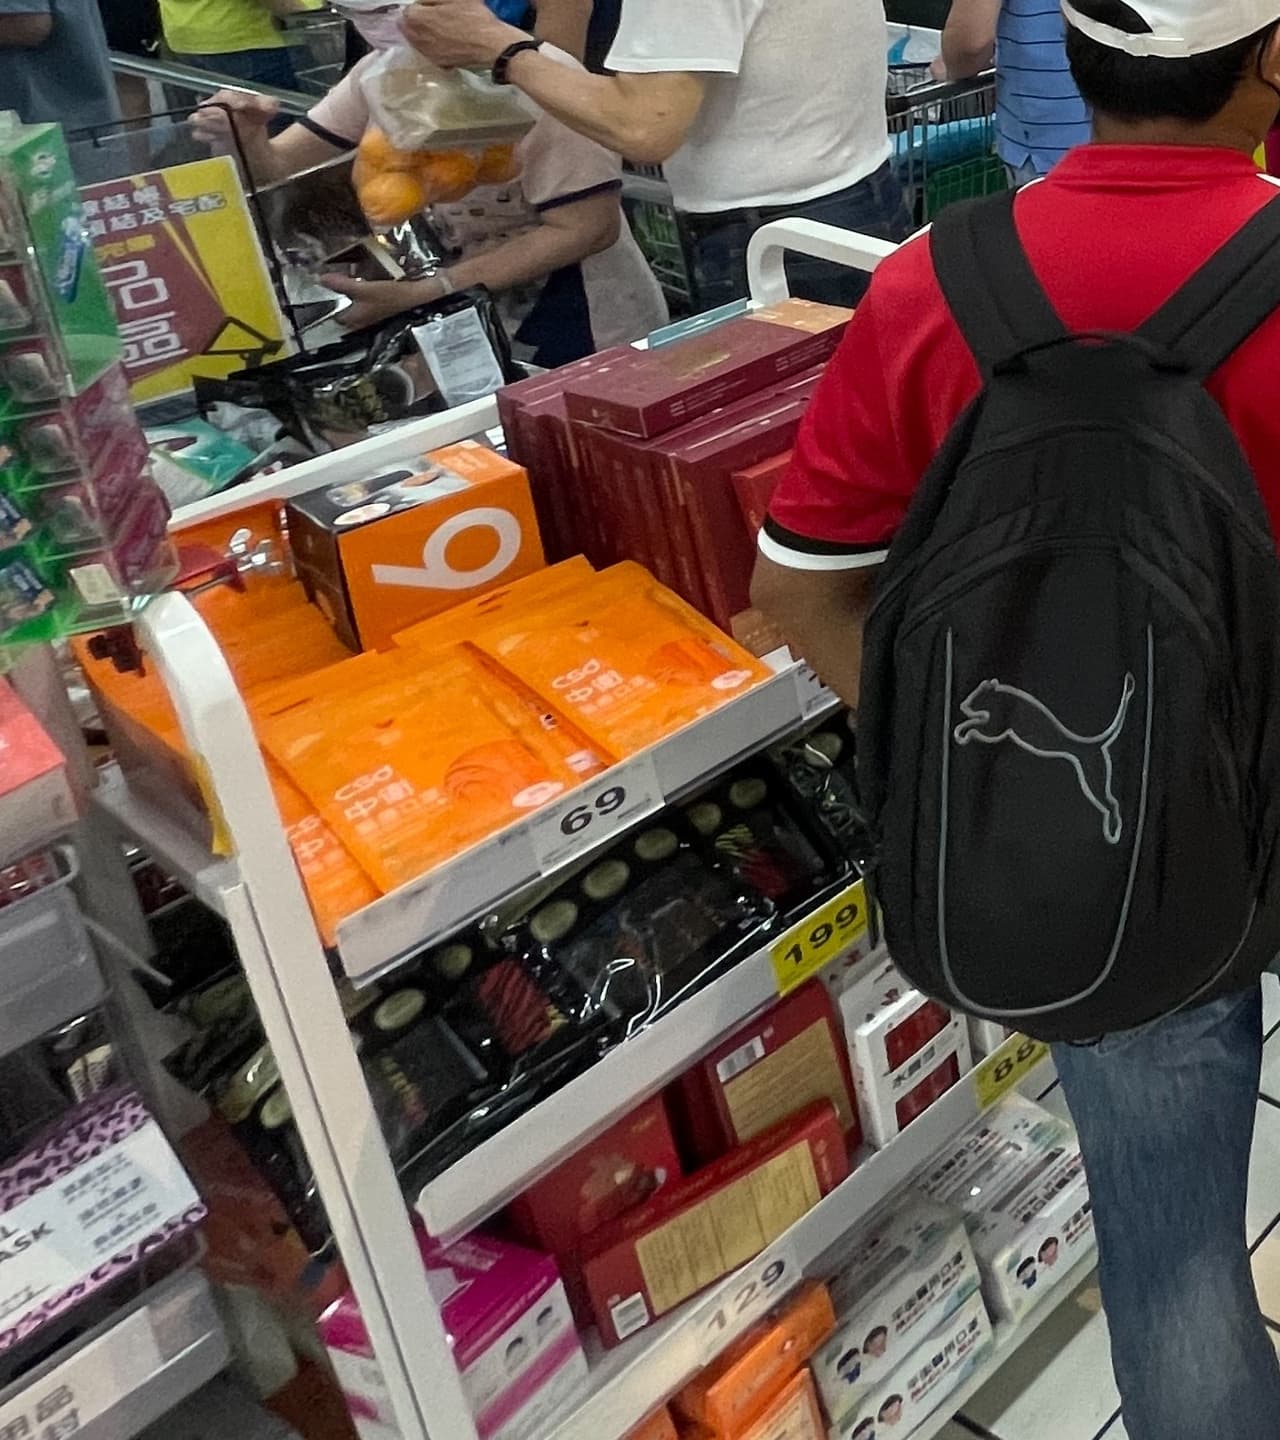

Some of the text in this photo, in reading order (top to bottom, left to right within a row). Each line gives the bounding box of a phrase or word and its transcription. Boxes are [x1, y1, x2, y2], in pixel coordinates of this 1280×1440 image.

[560, 786, 626, 835] 69
[784, 902, 859, 966] 199
[707, 1259, 786, 1332] 129
